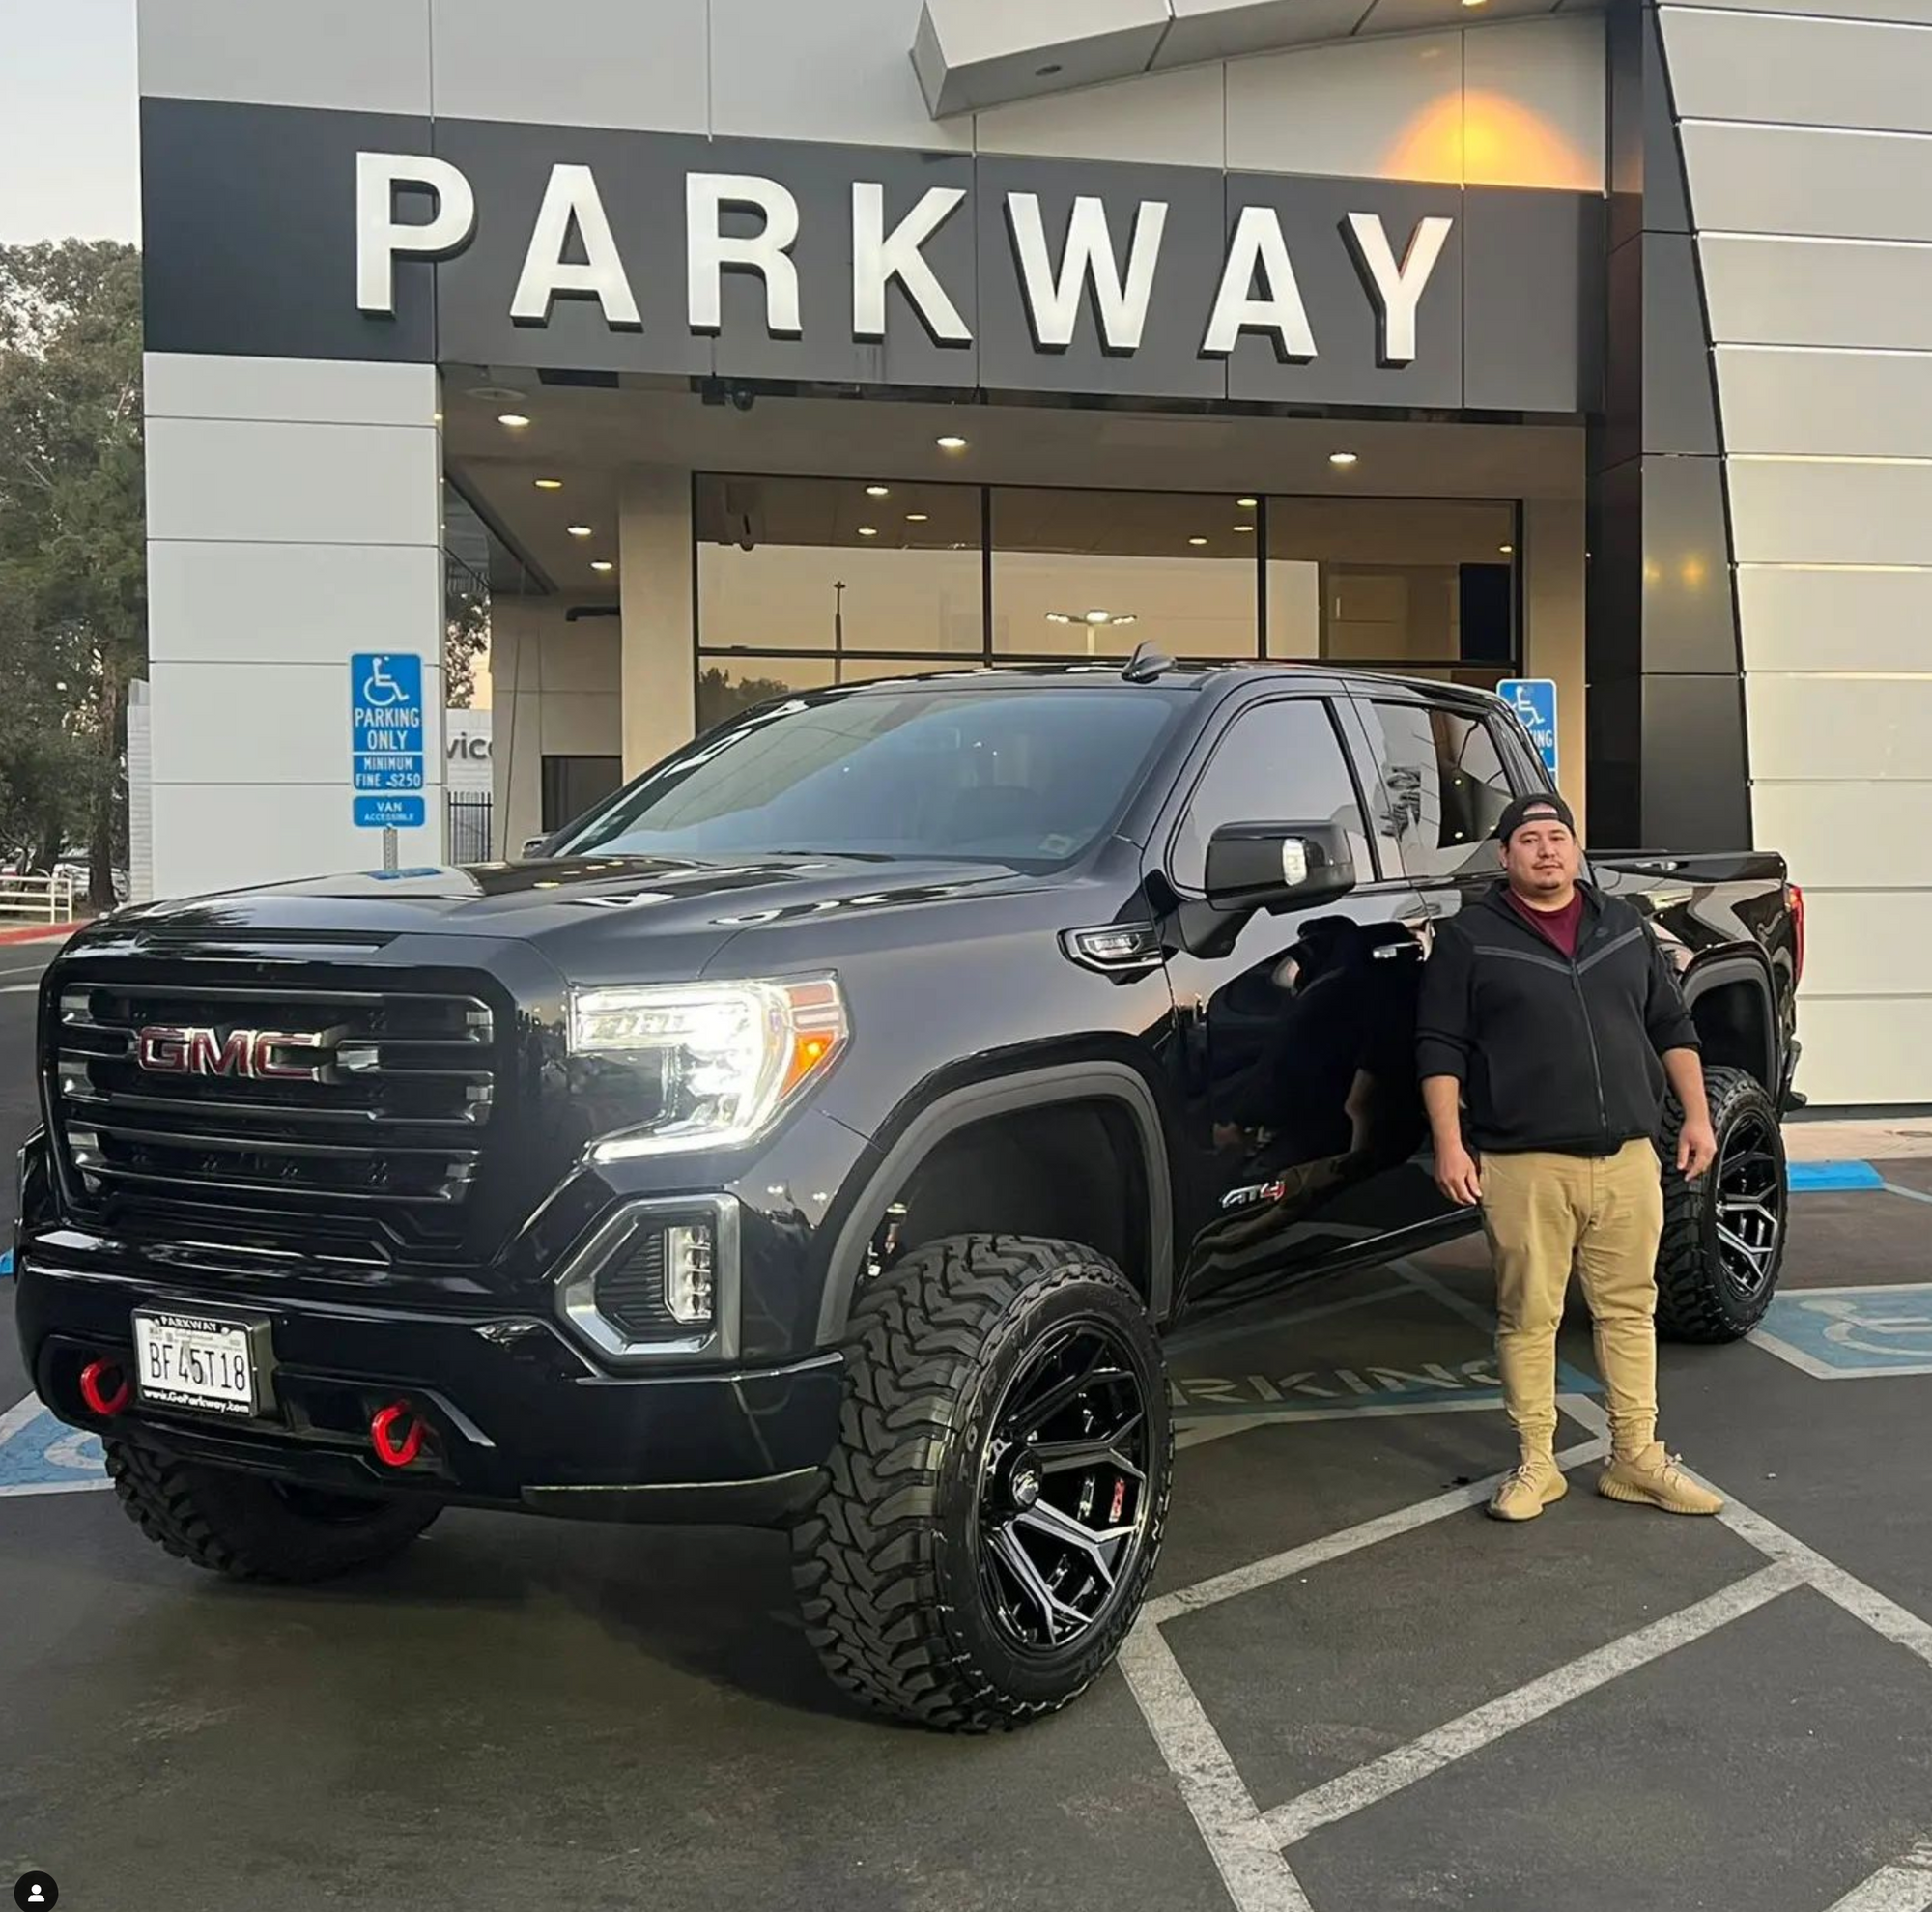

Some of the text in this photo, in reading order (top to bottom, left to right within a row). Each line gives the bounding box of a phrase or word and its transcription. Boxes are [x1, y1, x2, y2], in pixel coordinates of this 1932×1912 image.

[355, 151, 1454, 365] PARKWAY
[355, 707, 419, 728] PARKING
[367, 729, 408, 750] ONLY
[446, 731, 492, 760] vic
[364, 756, 413, 771] MINIMUM
[355, 773, 381, 787] FINE
[376, 801, 402, 813] VAN
[139, 1026, 322, 1083] GMC
[159, 1315, 217, 1332] PARKWAY
[149, 1342, 245, 1391] BF45T18
[143, 1388, 250, 1413] www.GoParkway.com
